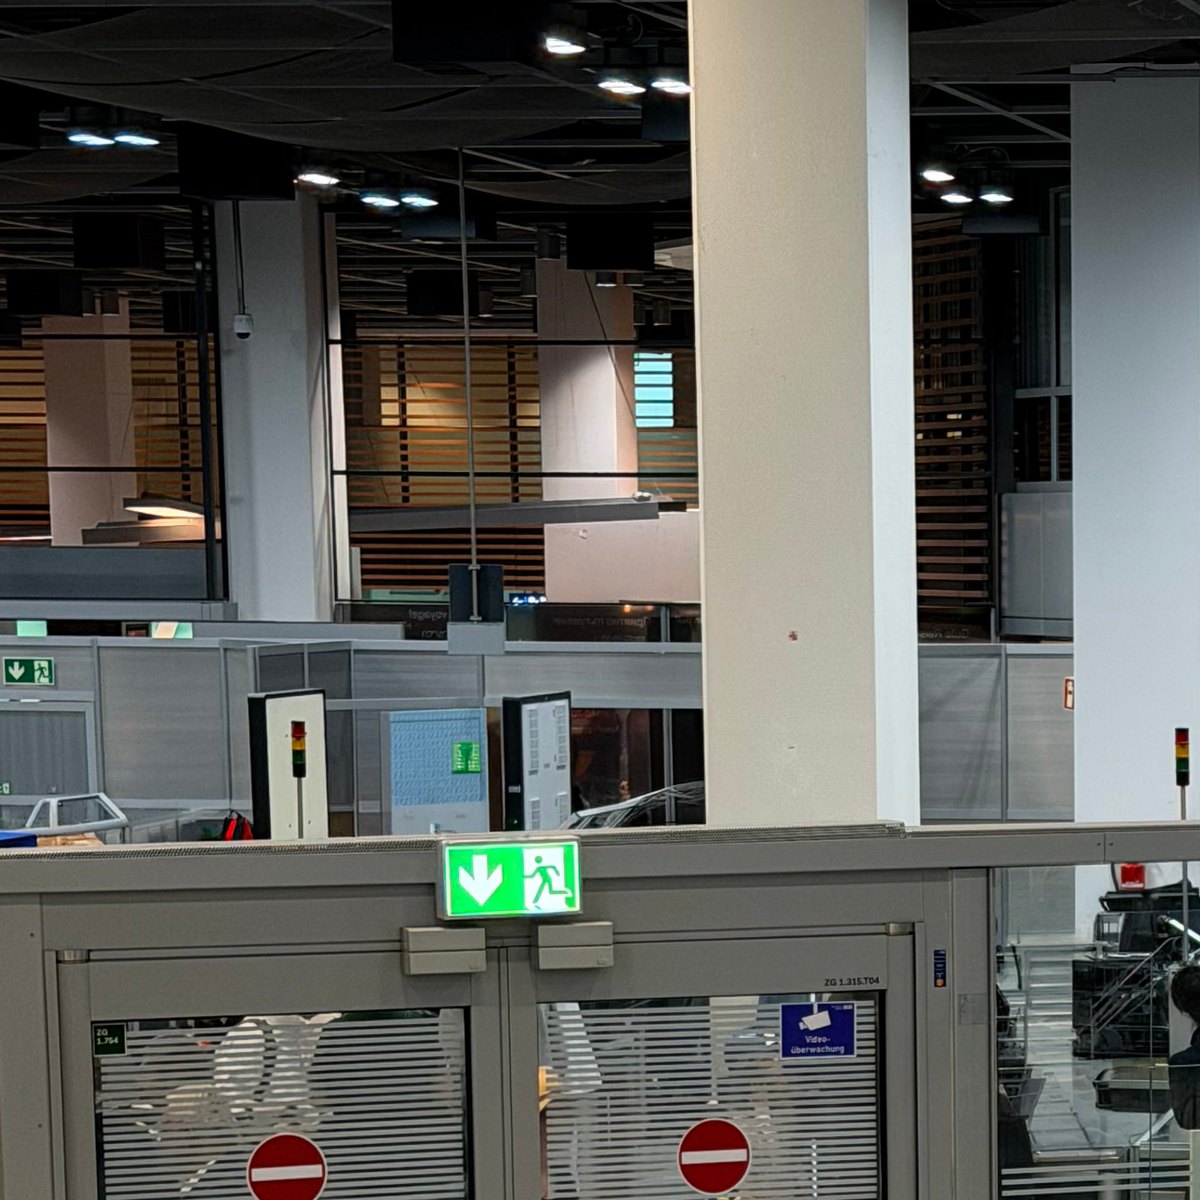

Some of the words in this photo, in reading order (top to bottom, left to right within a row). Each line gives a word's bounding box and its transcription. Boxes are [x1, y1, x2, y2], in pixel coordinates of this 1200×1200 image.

[824, 978, 837, 987] ZG
[839, 976, 880, 986] 1.315.T04
[805, 1035, 831, 1044] Video-
[790, 1045, 845, 1054] überwachung
